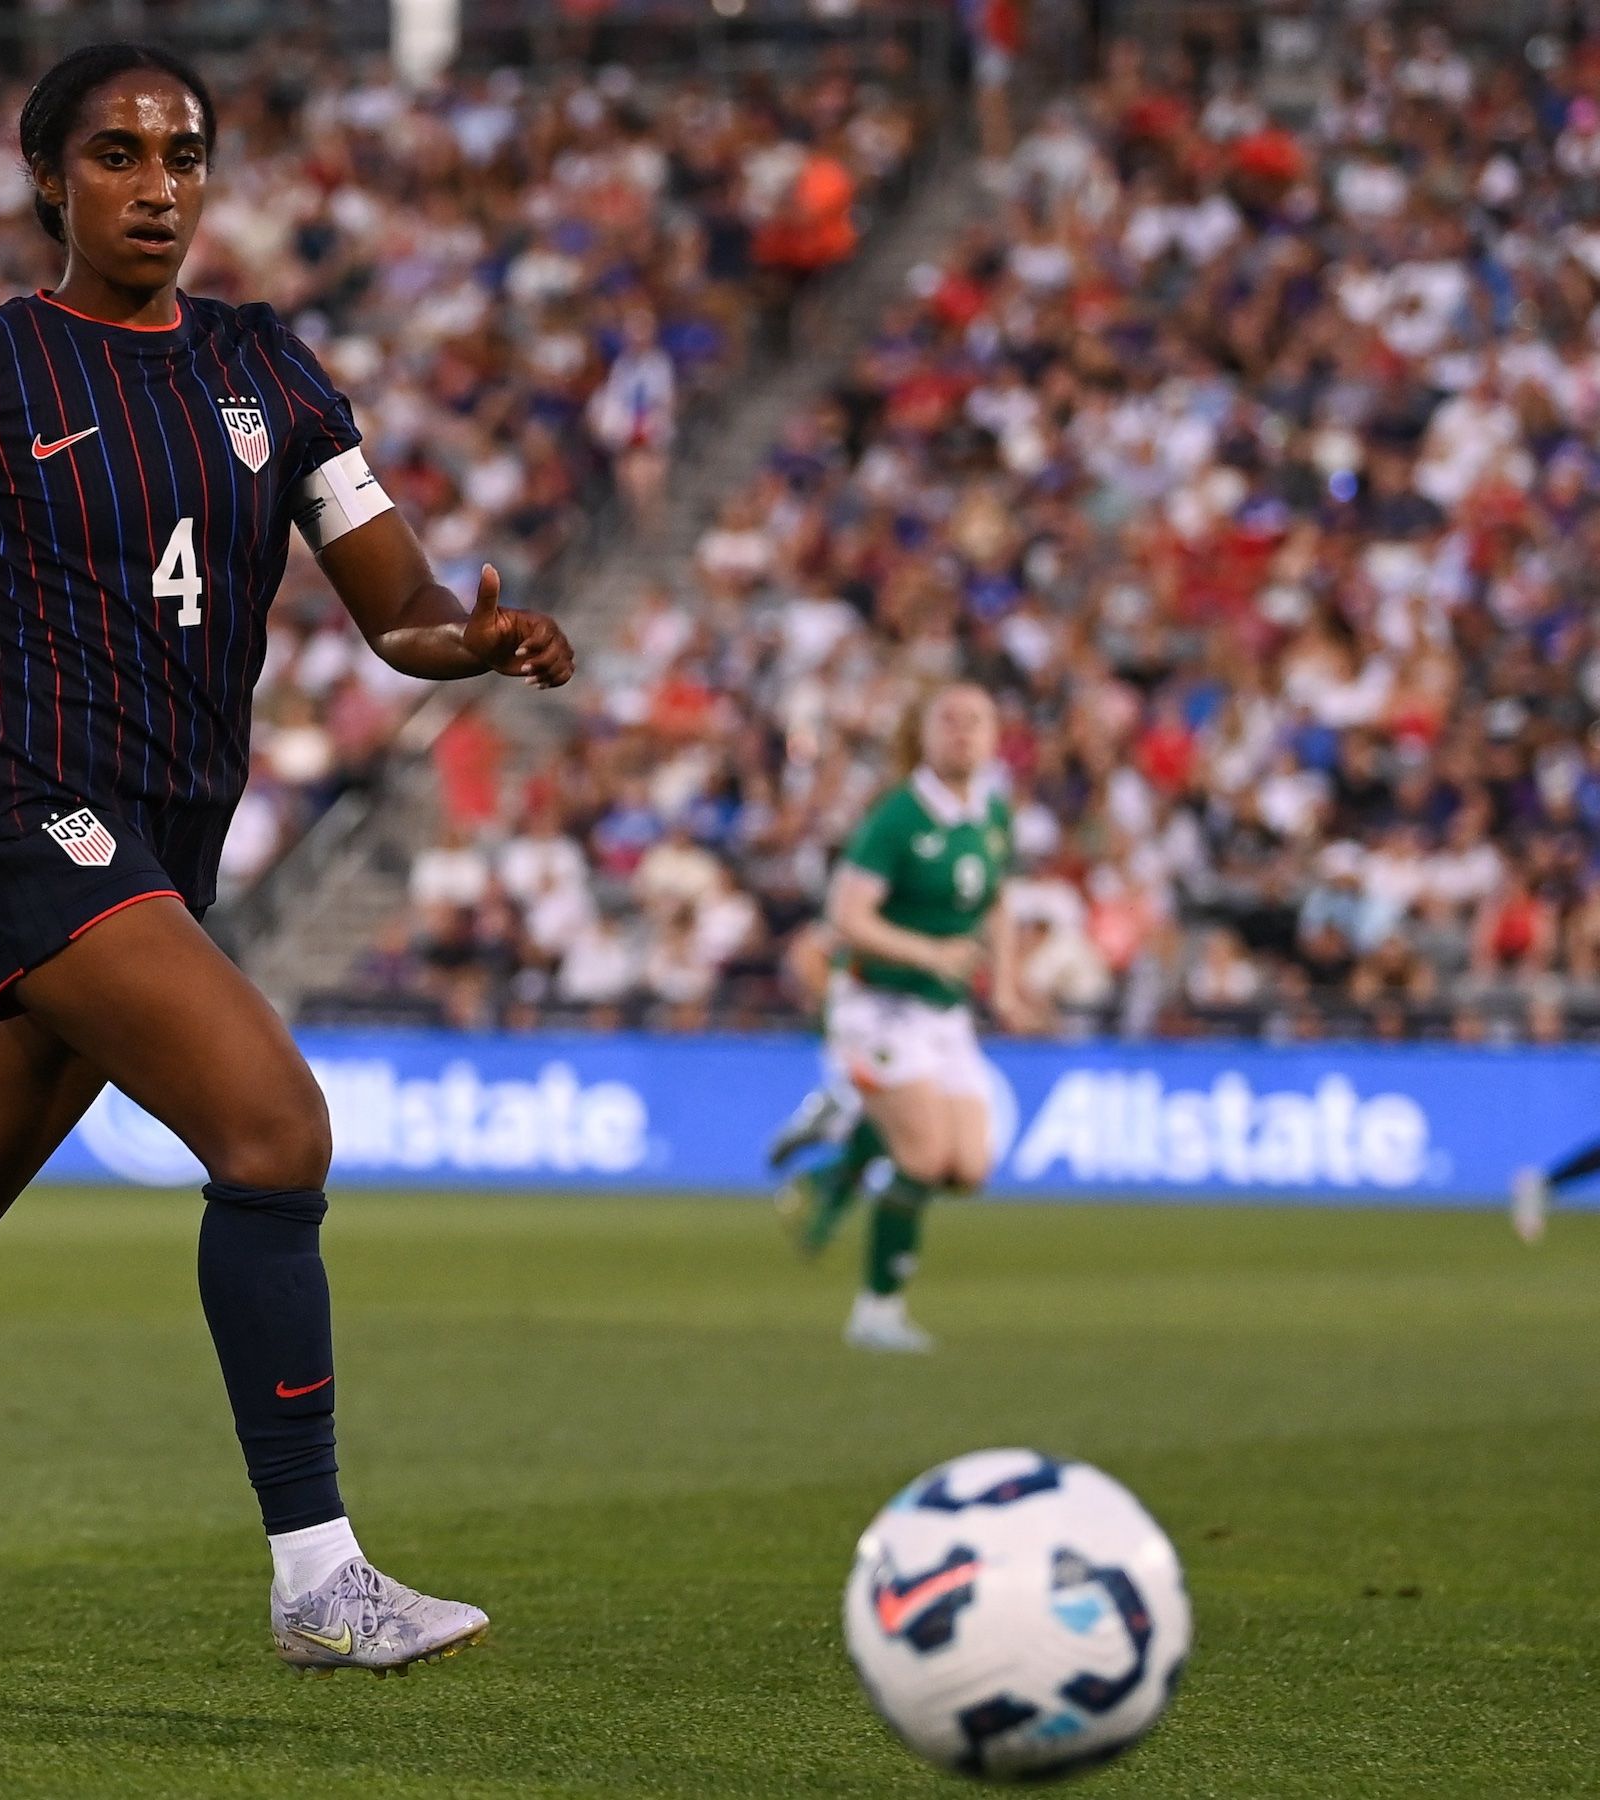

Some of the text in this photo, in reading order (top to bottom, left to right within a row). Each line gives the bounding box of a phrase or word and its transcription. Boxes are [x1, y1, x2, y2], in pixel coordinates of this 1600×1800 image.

[225, 411, 262, 435] USA
[152, 517, 203, 627] 4
[52, 812, 95, 841] USA
[305, 1059, 648, 1172] llstate
[1013, 1068, 1428, 1186] Allstate
